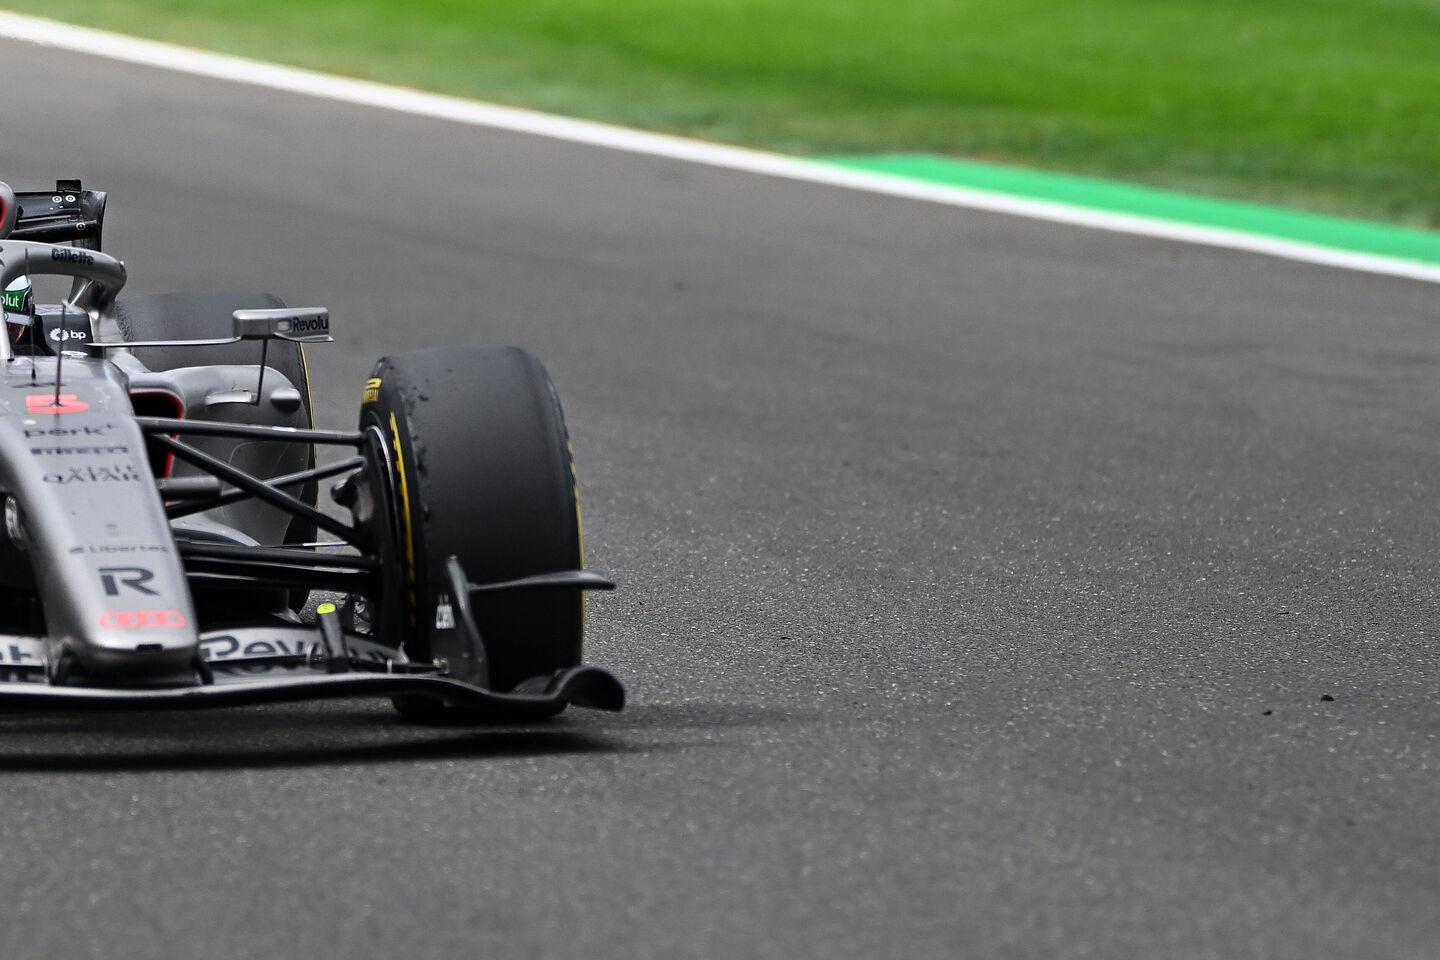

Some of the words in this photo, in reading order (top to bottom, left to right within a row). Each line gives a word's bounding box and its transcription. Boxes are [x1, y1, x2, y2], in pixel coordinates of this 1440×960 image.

[51, 248, 94, 265] Gillette
[70, 329, 86, 340] bp
[98, 567, 160, 597] R
